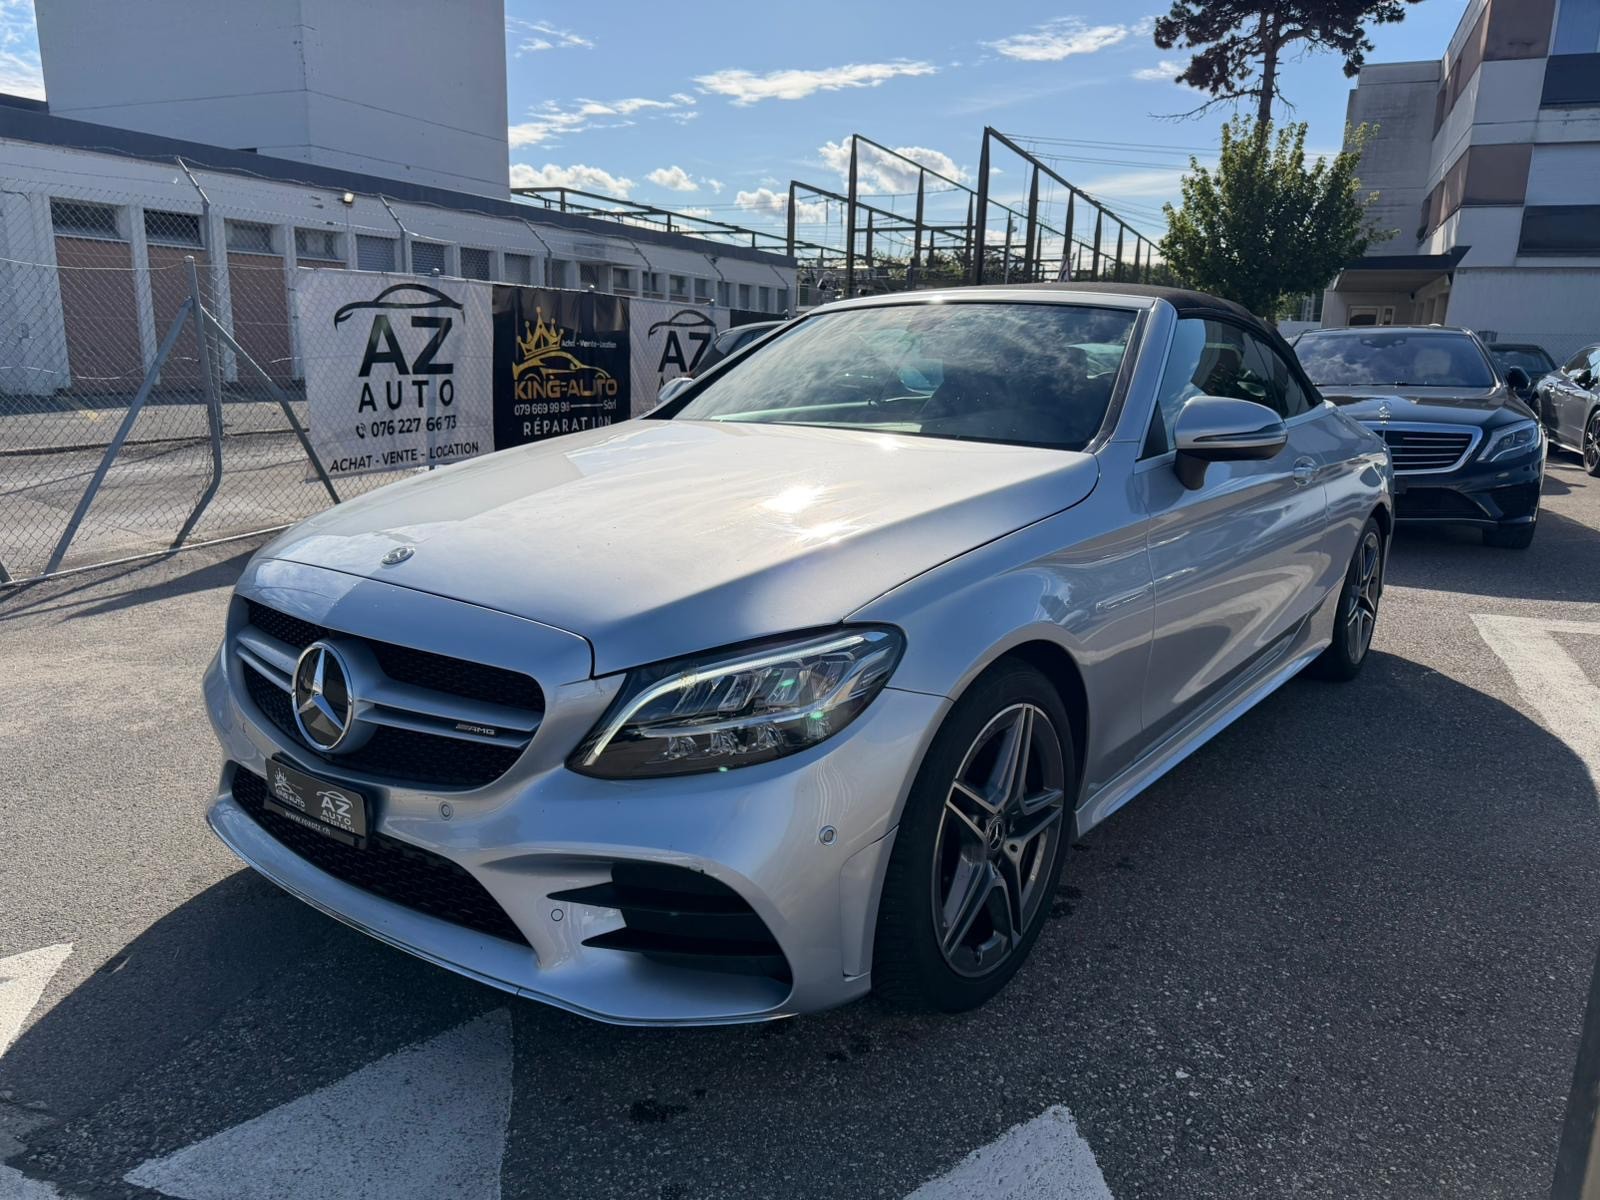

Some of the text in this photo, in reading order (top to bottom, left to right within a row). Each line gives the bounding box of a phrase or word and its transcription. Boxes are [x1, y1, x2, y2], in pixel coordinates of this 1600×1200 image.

[358, 314, 454, 377] AZ
[358, 379, 454, 413] AUTO
[514, 404, 531, 416] 079
[531, 403, 547, 414] 669
[371, 414, 457, 437] 076 227 66 73
[329, 454, 372, 472] ACHAT
[381, 448, 417, 465] VENTE
[429, 441, 479, 459] LOCATION
[321, 796, 351, 818] AZ
[321, 809, 351, 826] AUTO
